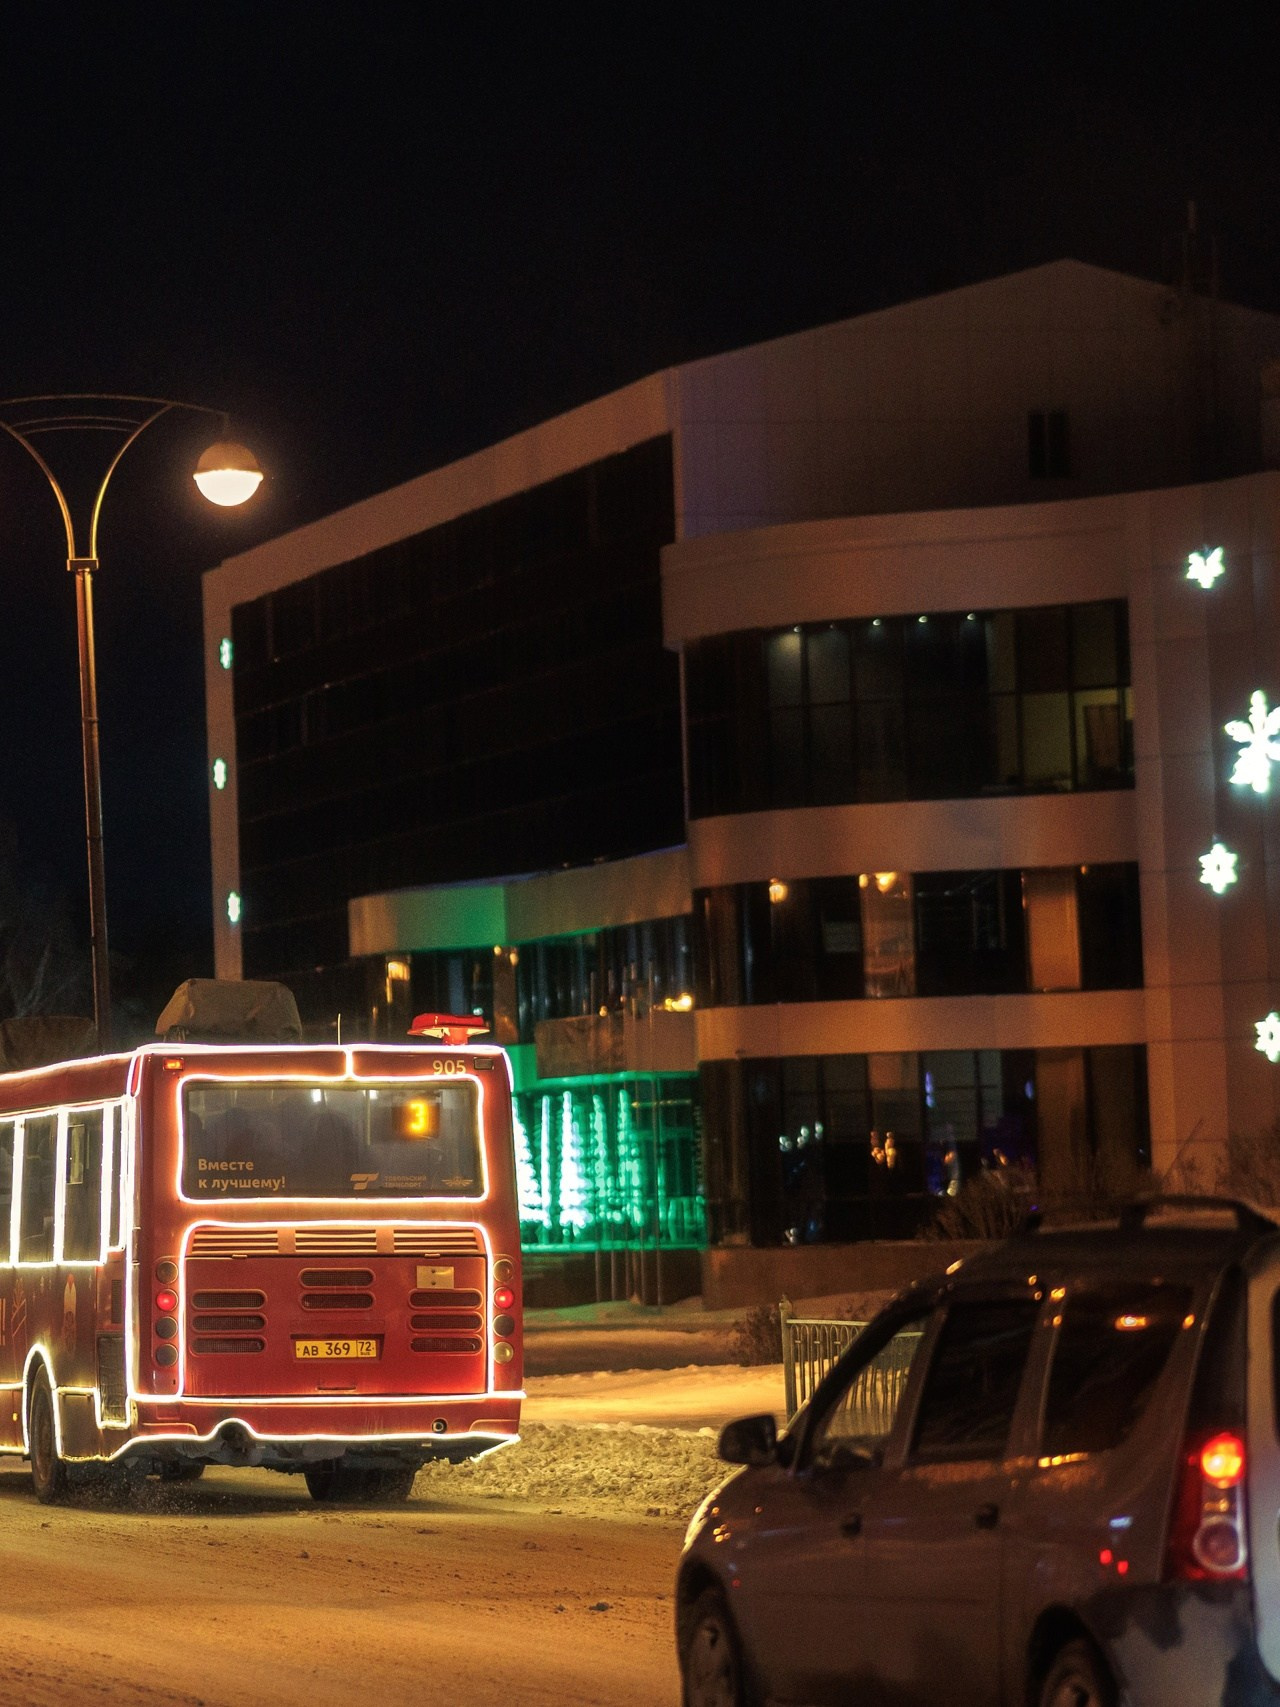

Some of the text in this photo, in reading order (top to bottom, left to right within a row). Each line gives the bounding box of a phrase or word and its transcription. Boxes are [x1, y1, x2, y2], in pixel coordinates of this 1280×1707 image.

[432, 1060, 467, 1075] 905
[409, 1102, 429, 1132] 3
[198, 1158, 254, 1171] Вместе
[198, 1176, 286, 1191] к лучшему!
[325, 1342, 351, 1356] 369
[357, 1341, 372, 1352] 72
